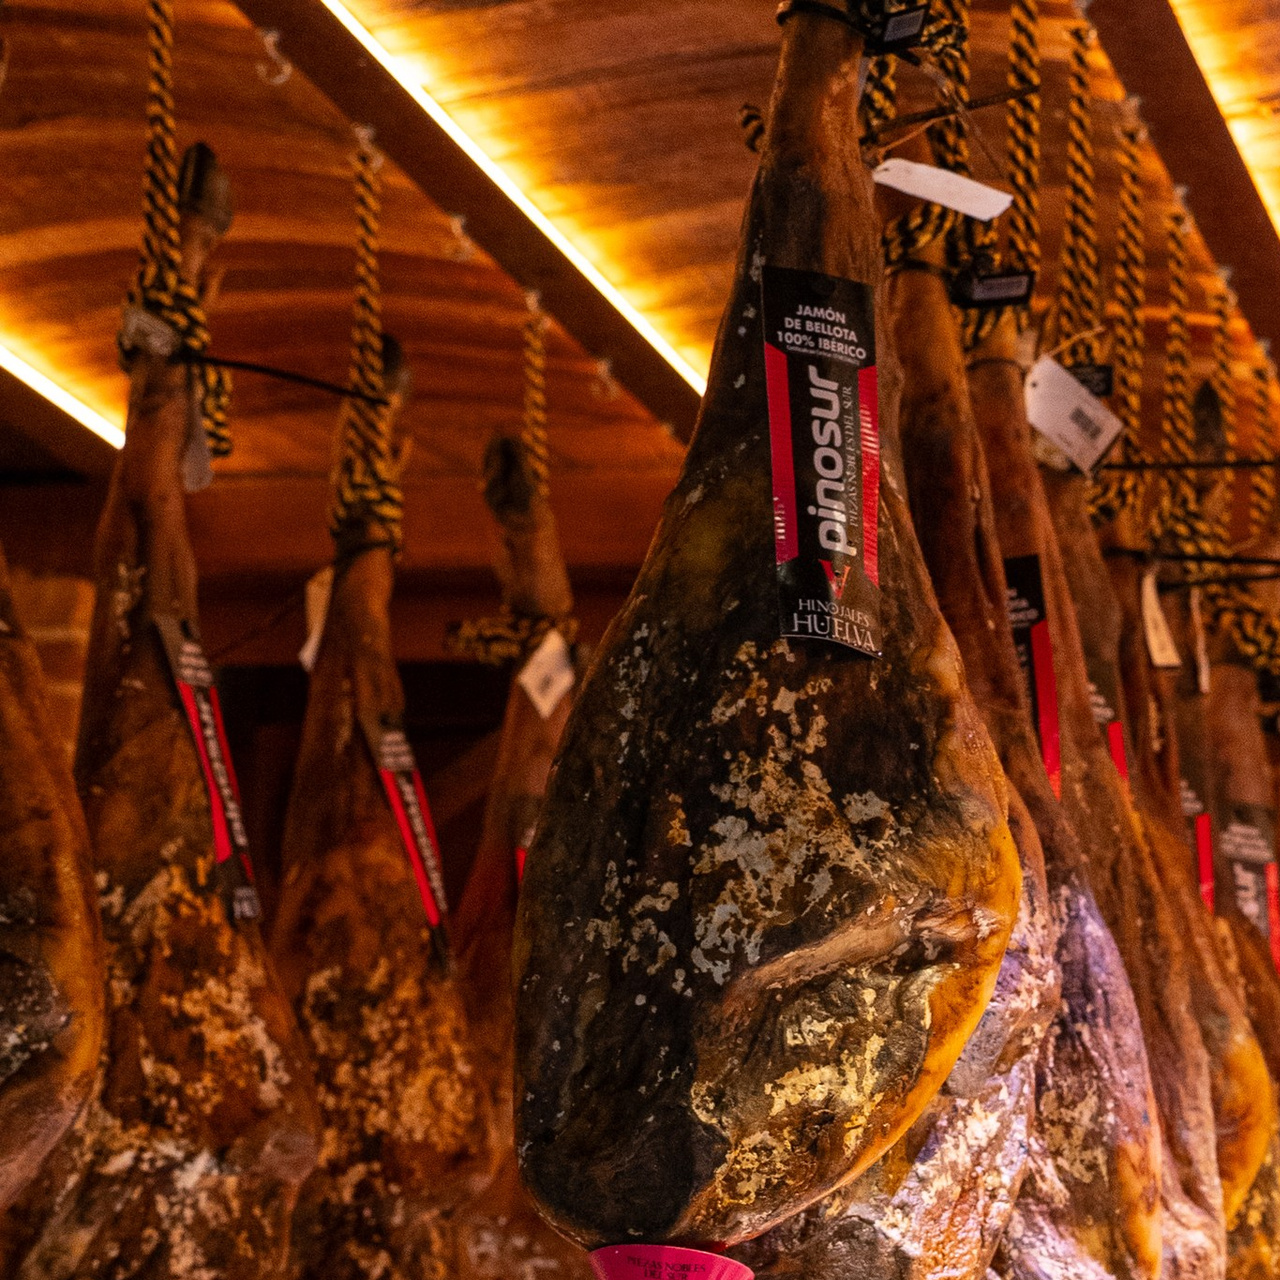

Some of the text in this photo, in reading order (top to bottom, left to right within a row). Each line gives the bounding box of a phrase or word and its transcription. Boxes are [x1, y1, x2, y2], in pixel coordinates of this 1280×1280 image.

[796, 304, 846, 325] JAMÓN
[784, 317, 858, 343] DE BELLOTA
[777, 331, 815, 348] 100%
[818, 337, 867, 360] IBÉRICO
[842, 386, 853, 410] SUR
[807, 364, 857, 557] pinosur
[847, 489, 859, 528] PIEZAS
[798, 599, 871, 628] HINOJALES
[792, 612, 877, 652] HUELVA
[626, 1256, 706, 1274] PIEZAS NOBLES
[644, 1269, 664, 1279] DEL
